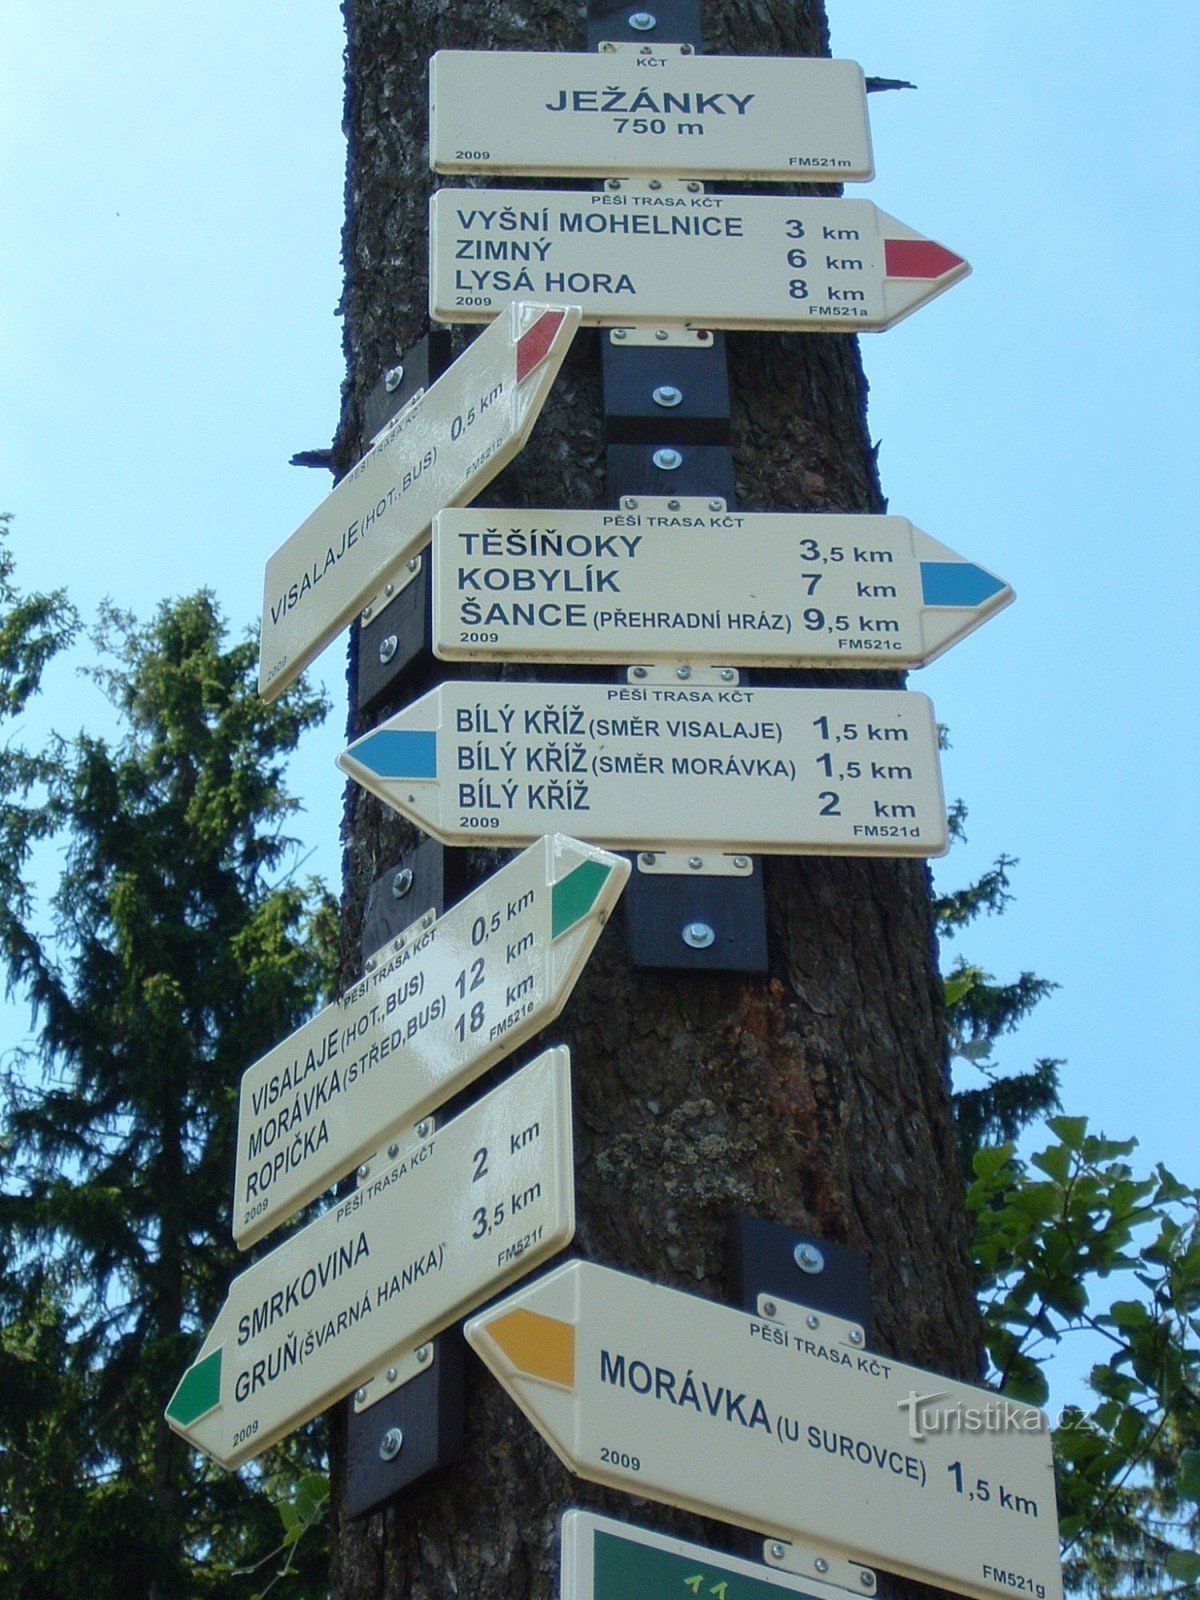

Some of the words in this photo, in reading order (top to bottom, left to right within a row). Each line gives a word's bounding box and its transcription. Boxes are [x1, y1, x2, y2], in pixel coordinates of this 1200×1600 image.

[637, 57, 667, 67] KČT
[545, 86, 755, 115] JEŽÁNKY
[613, 118, 666, 134] 750
[678, 122, 704, 135] m
[456, 151, 490, 160] 2009
[789, 157, 851, 167] FM521m
[591, 195, 627, 206] PĚŠÍ
[632, 196, 687, 207] TRASA
[691, 197, 723, 208] KČT
[456, 206, 549, 231] VYŠNÍ
[560, 212, 743, 237] MOHELNICE
[785, 219, 805, 239] 3
[823, 226, 860, 240] km
[455, 237, 552, 261] ZIMNÝ
[787, 249, 807, 268] 6
[826, 256, 863, 269] km
[455, 267, 535, 291] LYSÁ
[545, 272, 637, 294] HORA
[789, 279, 809, 299] 8
[828, 287, 865, 301] km
[455, 296, 492, 306] 2009
[808, 306, 868, 316] FM521a
[271, 520, 359, 625] VISALAJE
[451, 407, 475, 441] 0,5
[480, 383, 503, 412] km
[603, 514, 641, 526] PĚŠÍ
[646, 517, 705, 528] TRASA
[710, 517, 744, 528] KČT
[458, 528, 643, 558] TĚŠÍŇOKY
[799, 539, 845, 564] 3,5
[854, 548, 893, 563] km
[458, 565, 620, 592] KOBYLÍK
[801, 574, 823, 596] 7
[857, 582, 897, 597] km
[460, 597, 587, 627] ŠANCE
[593, 608, 721, 631] (PŘEHRADNÍ
[728, 610, 792, 634] HRÁZ)
[803, 608, 849, 634] 9,5
[860, 616, 899, 632] km
[460, 633, 499, 643] 2009
[838, 639, 902, 650] FM521c
[267, 655, 287, 682] 2009
[607, 689, 647, 701] PĚŠÍ
[652, 691, 713, 702] TRASA
[718, 691, 754, 703] KČT
[456, 703, 515, 734] BÍLÝ
[666, 720, 782, 744] VISALAJE)
[813, 715, 858, 743] 1,5
[868, 724, 909, 741] km
[458, 741, 517, 771] BÍLÝ
[672, 755, 796, 781] MORÁVKA)
[816, 753, 862, 782] 1,5
[871, 762, 913, 779] km
[459, 778, 519, 809] BÍLÝ
[528, 779, 590, 810] KŘÍŽ
[818, 791, 841, 816] 2
[874, 800, 916, 818] km
[459, 817, 500, 828] 2009
[853, 825, 920, 837] FM521d
[344, 981, 369, 1009] PĚŠÍ
[372, 952, 410, 986] TRASA
[413, 929, 437, 956] KČT
[252, 1028, 339, 1117] VISALAJE
[471, 911, 500, 946] 0,5
[507, 889, 534, 921] km
[490, 1002, 534, 1041] FM521e
[248, 1070, 341, 1161] MORÁVKA
[455, 957, 485, 1000] 12
[507, 932, 534, 963] km
[246, 1119, 329, 1202] ROPIČKA
[454, 1001, 485, 1043] 18
[506, 975, 534, 1007] km
[336, 1194, 363, 1222] PĚŠÍ
[367, 1163, 408, 1200] TRASA
[411, 1141, 435, 1169] KČT
[244, 1198, 269, 1225] 2009
[237, 1231, 370, 1346] SMRKOVINA
[472, 1147, 488, 1183] 2
[510, 1122, 540, 1155] km
[497, 1225, 544, 1267] FM521f
[235, 1331, 297, 1403] GRUŇ
[377, 1244, 443, 1307] HANKA)
[472, 1203, 504, 1240] 3,5
[511, 1182, 541, 1215] km
[750, 1323, 789, 1347] PĚŠÍ
[794, 1337, 853, 1368] TRASA
[857, 1357, 891, 1379] KČT
[232, 1420, 259, 1448] 2009
[600, 1349, 772, 1434] MORÁVKA
[777, 1416, 799, 1443] (U
[807, 1426, 927, 1487] SUROVCE)
[947, 1461, 990, 1501] 1,5
[1000, 1485, 1038, 1517] km
[600, 1447, 641, 1471] 2009
[982, 1564, 1045, 1599] FM521g
